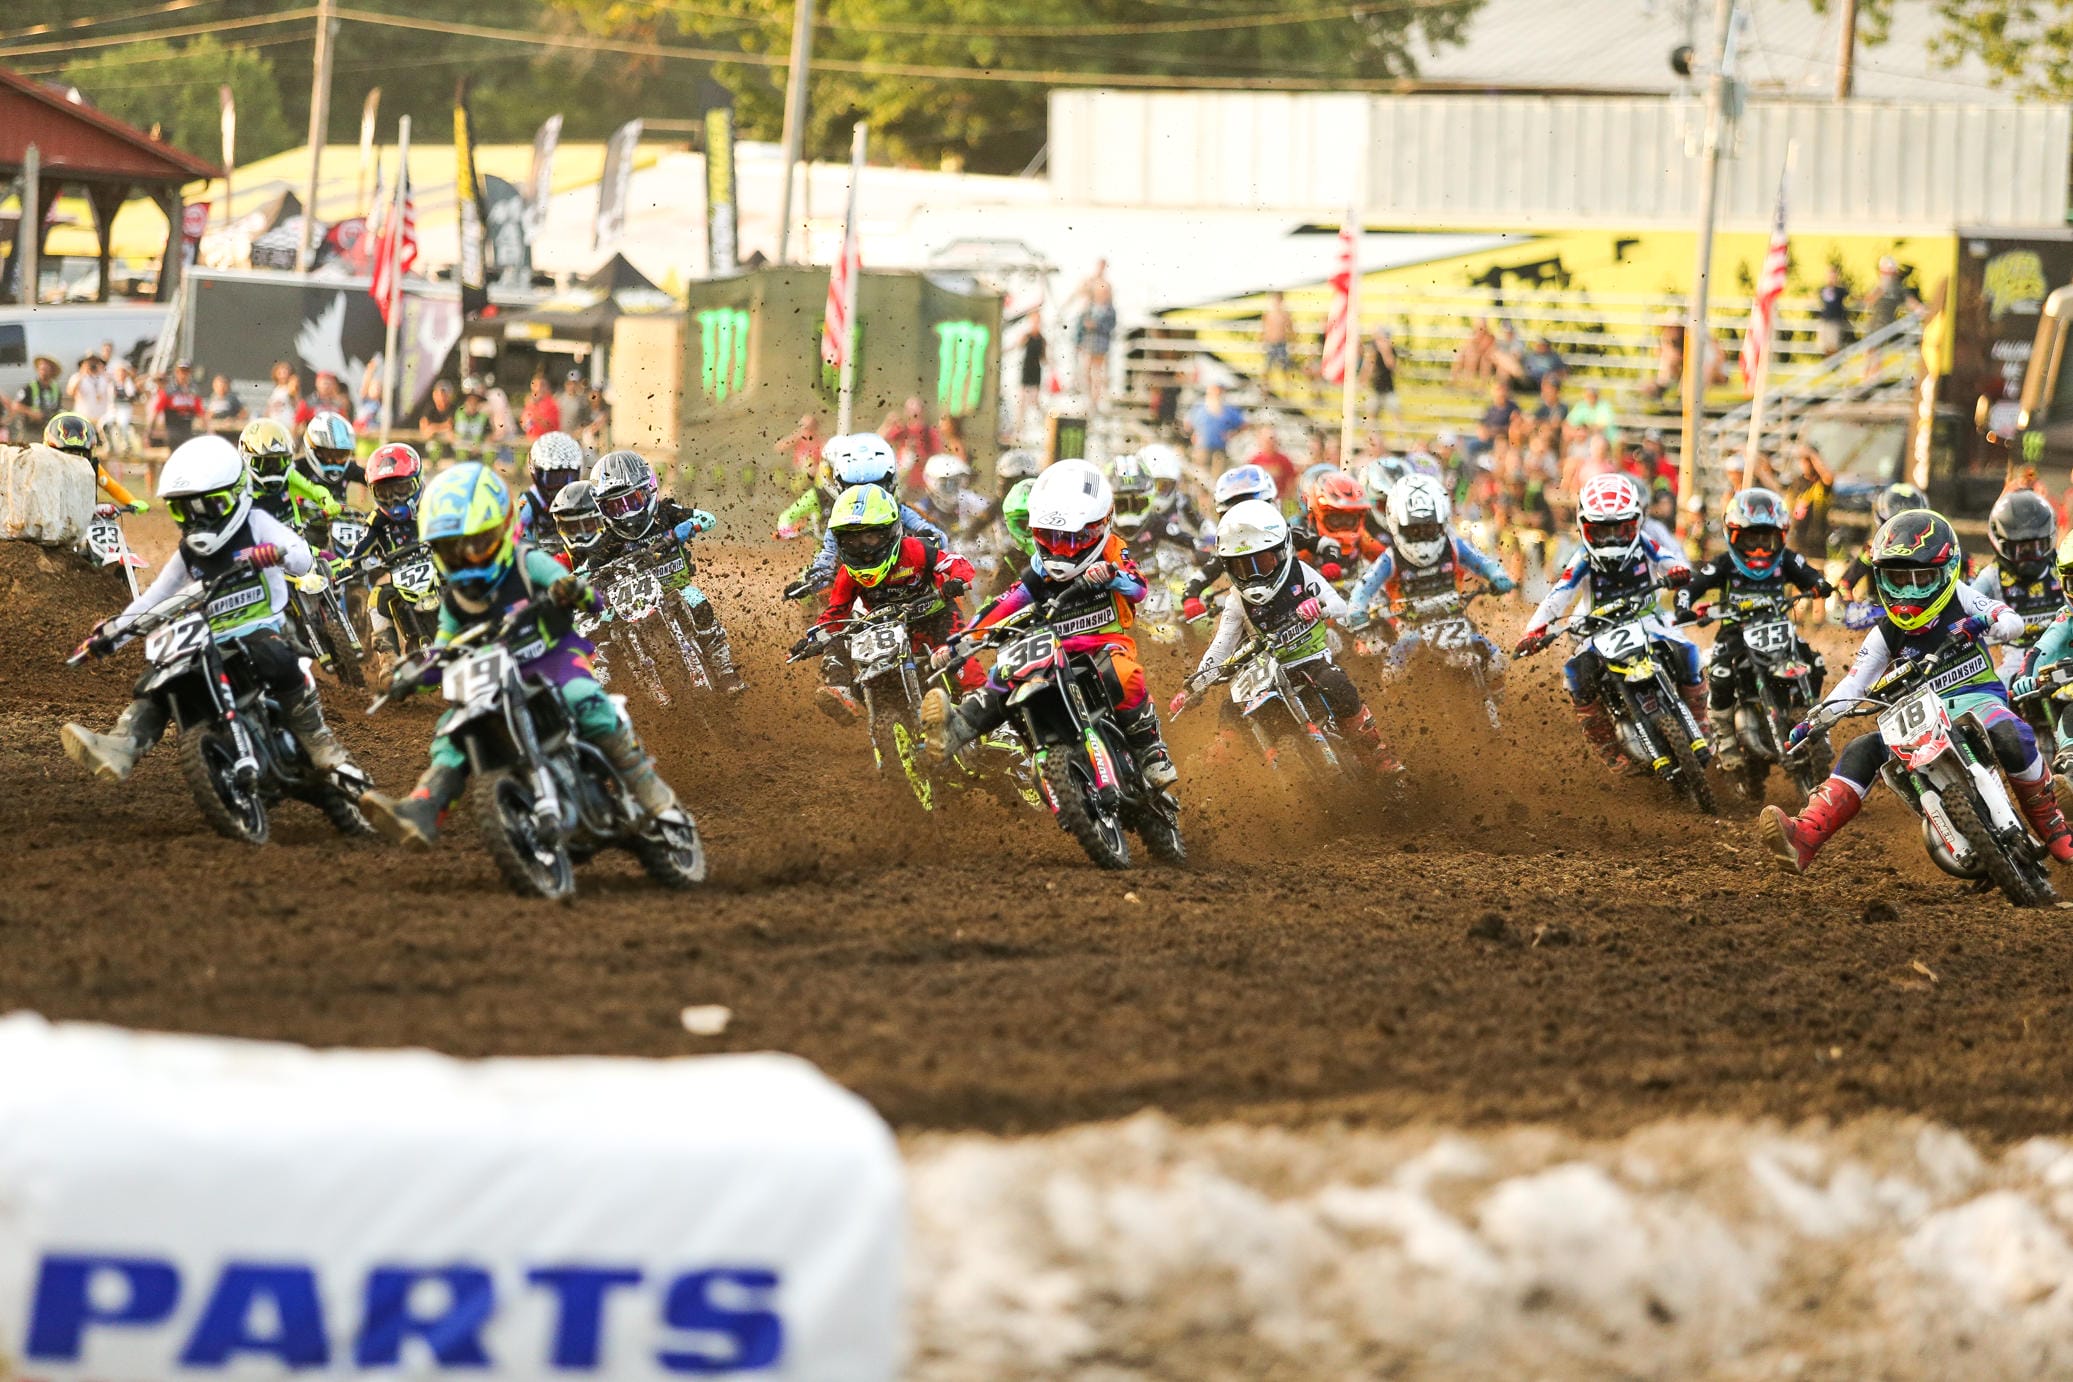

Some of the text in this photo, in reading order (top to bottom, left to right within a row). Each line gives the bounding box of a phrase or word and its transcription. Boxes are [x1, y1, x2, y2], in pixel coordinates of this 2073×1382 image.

[91, 526, 119, 543] 23
[401, 564, 430, 588] 52
[210, 588, 261, 613] AMPIONSHIP
[616, 578, 652, 606] 44
[1056, 609, 1112, 635] AMPIONSHIP
[1751, 624, 1789, 648] 33
[154, 620, 204, 662] 22
[1008, 633, 1052, 670] 36
[1610, 629, 1634, 654] 2
[453, 655, 501, 702] 19
[1930, 657, 1983, 692] AMPIONSHIP
[1895, 700, 1926, 738] 18
[1087, 732, 1110, 785] DUNLOP
[25, 1254, 784, 1374] PARTS
